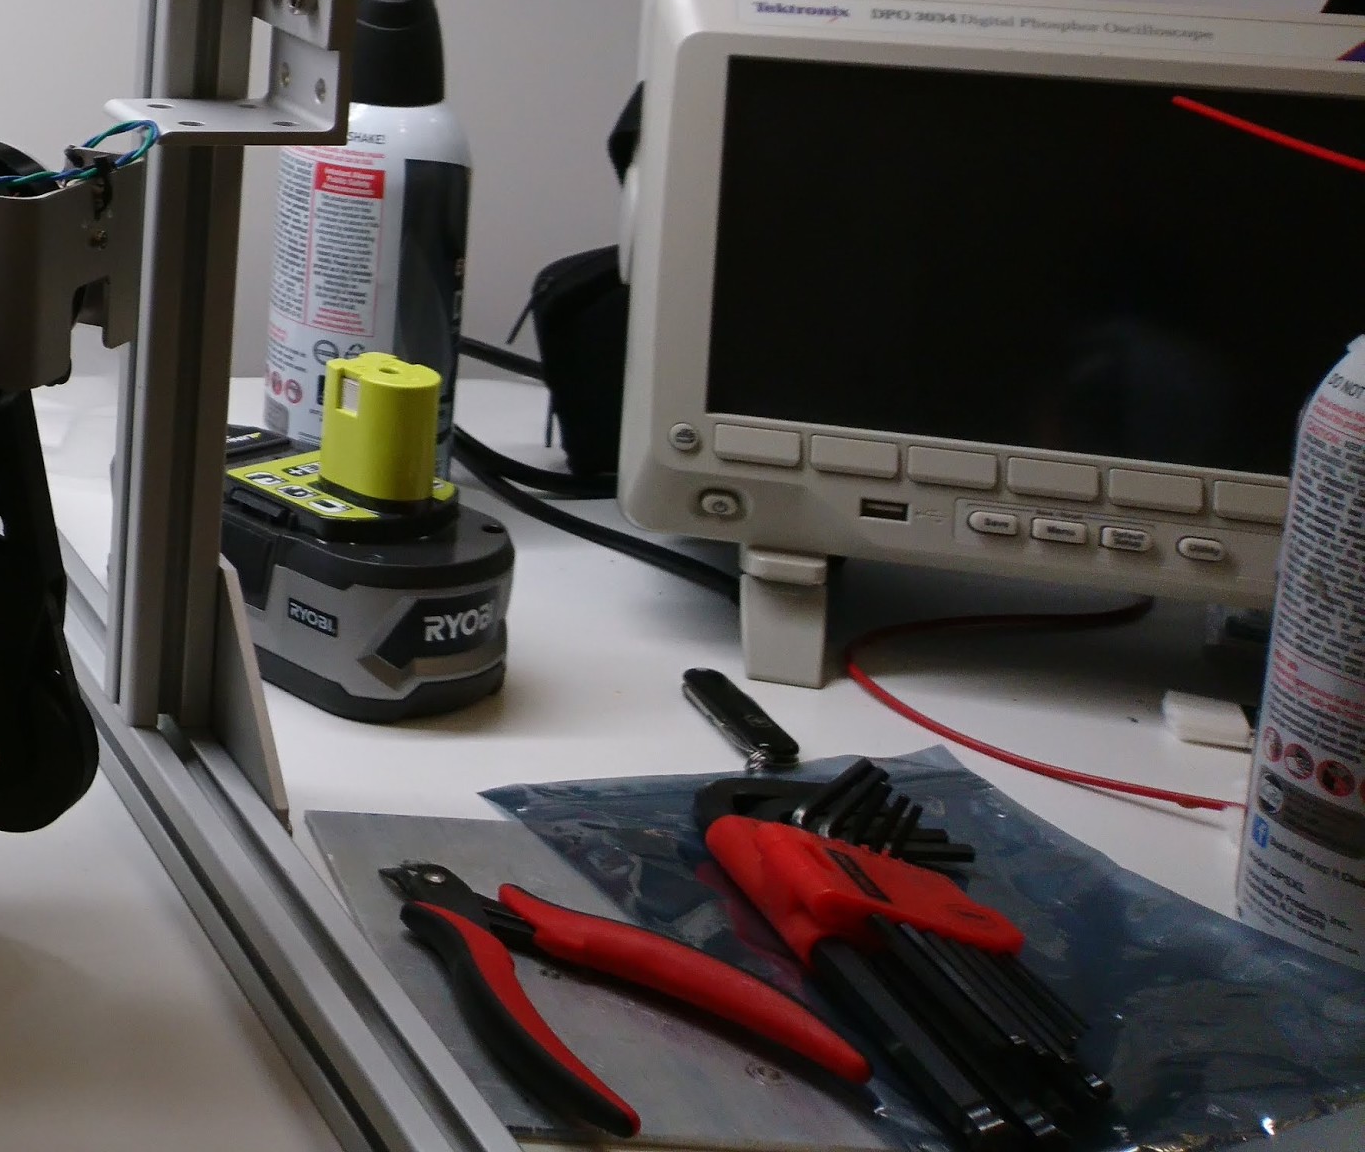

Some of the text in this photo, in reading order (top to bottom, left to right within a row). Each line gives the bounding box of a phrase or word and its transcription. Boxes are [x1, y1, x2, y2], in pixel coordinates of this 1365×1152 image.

[752, 0, 850, 18] Tektronix
[871, 8, 910, 21] DPO
[960, 14, 1015, 29] Digital
[1020, 17, 1098, 35] Phosphor
[1103, 23, 1215, 41] Oscilloscope
[289, 602, 335, 632] RYOBI
